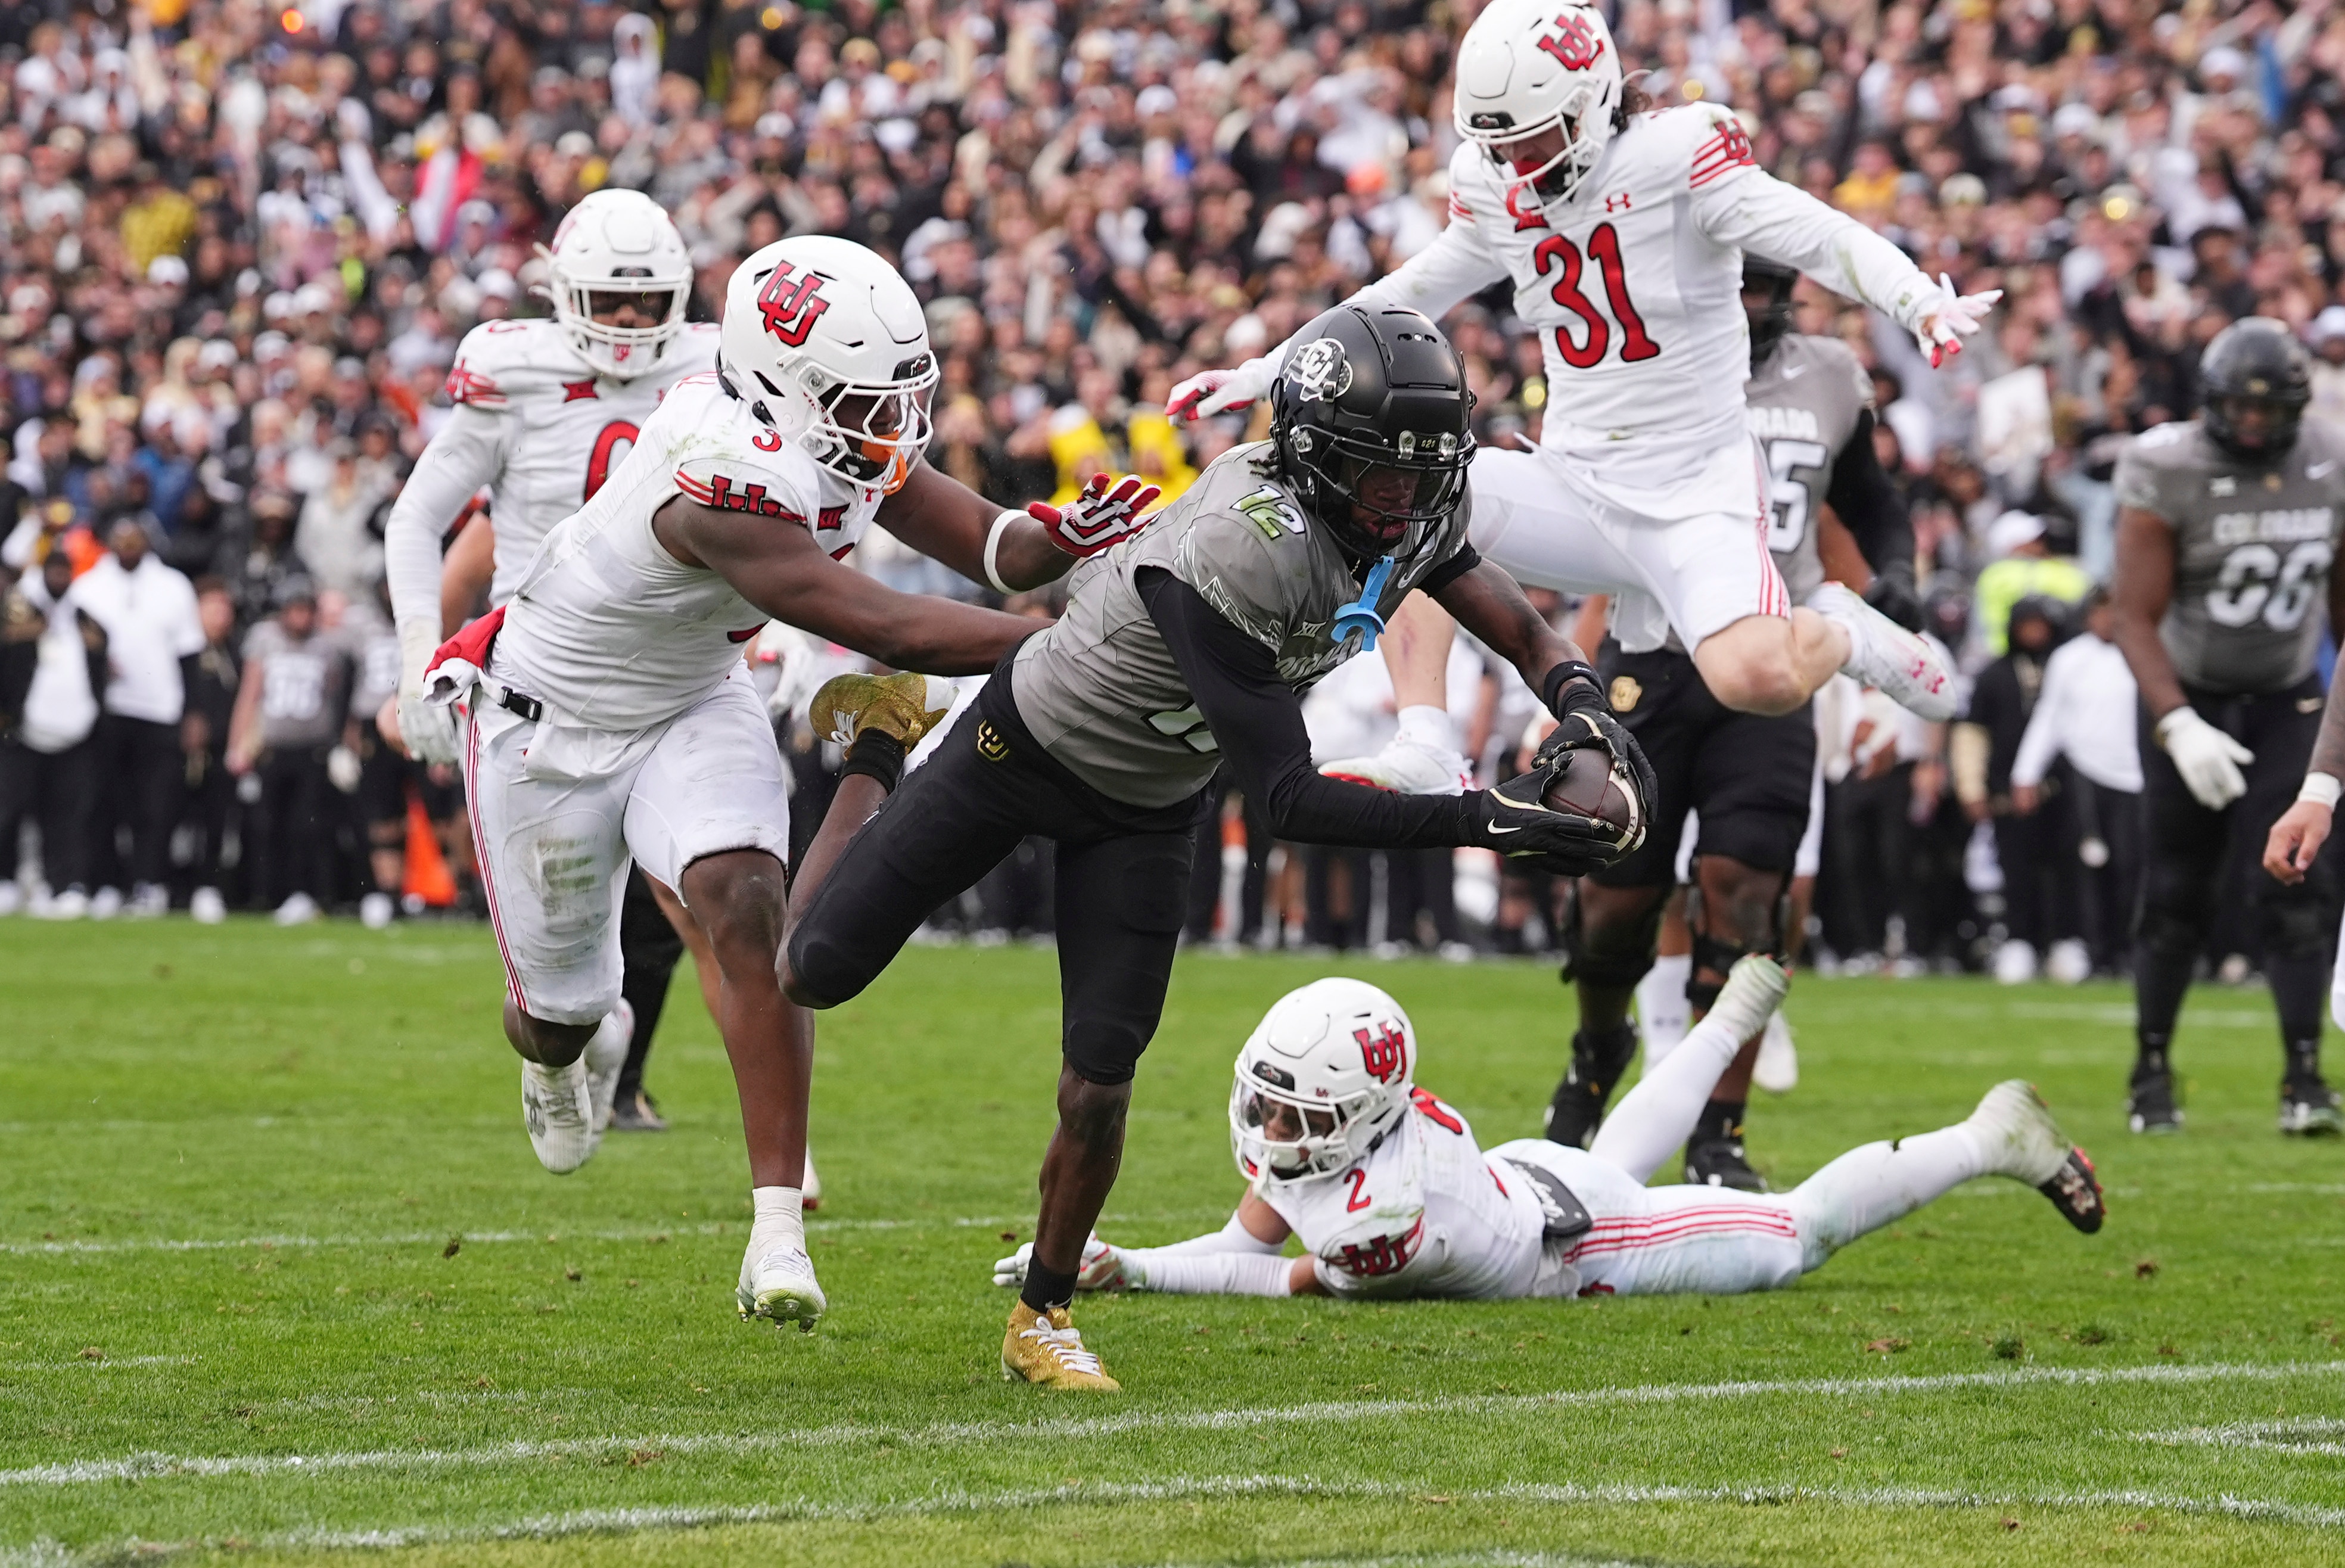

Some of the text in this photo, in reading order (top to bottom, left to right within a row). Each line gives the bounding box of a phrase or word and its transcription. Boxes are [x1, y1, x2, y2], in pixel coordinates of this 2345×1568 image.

[1534, 221, 1660, 368] 31
[752, 428, 782, 452] 3
[1229, 484, 1306, 541] 12
[1769, 439, 1826, 553] 5
[1344, 1168, 1370, 1213] 2
